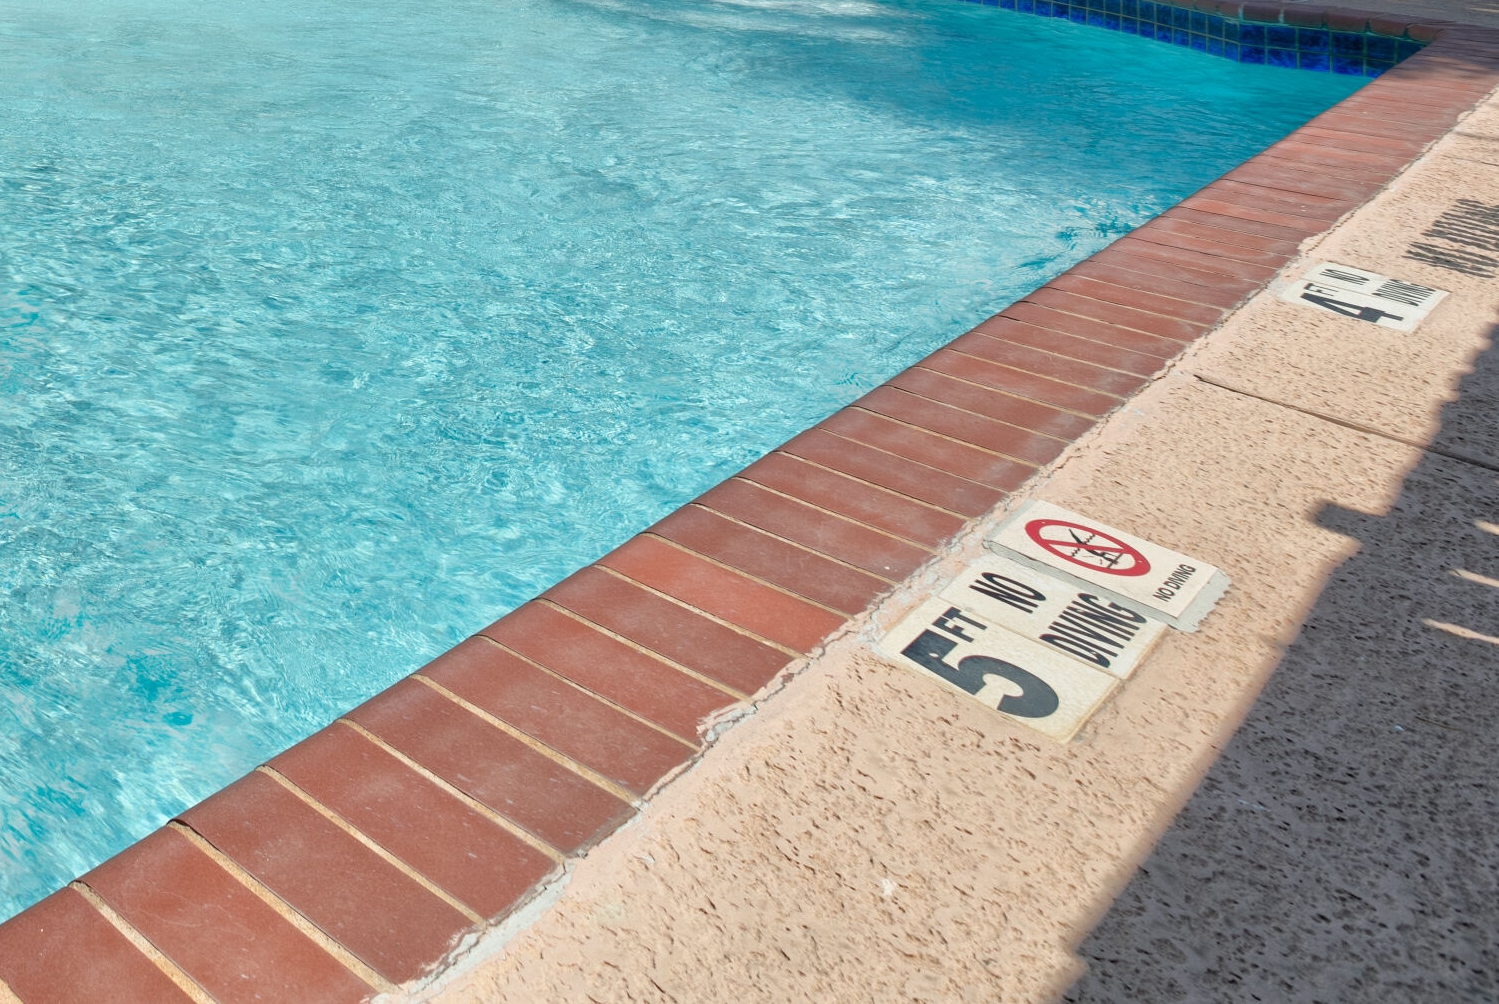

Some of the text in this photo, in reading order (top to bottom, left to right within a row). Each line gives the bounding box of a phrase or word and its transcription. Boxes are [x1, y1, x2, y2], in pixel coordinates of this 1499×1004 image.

[1319, 268, 1371, 286] NO
[1371, 278, 1437, 307] DIVING
[1299, 282, 1405, 323] 4 FT
[968, 571, 1047, 614] NO
[1152, 563, 1196, 602] NO DIVING
[1039, 592, 1148, 669] DIVING
[900, 607, 1060, 719] 5 FT
